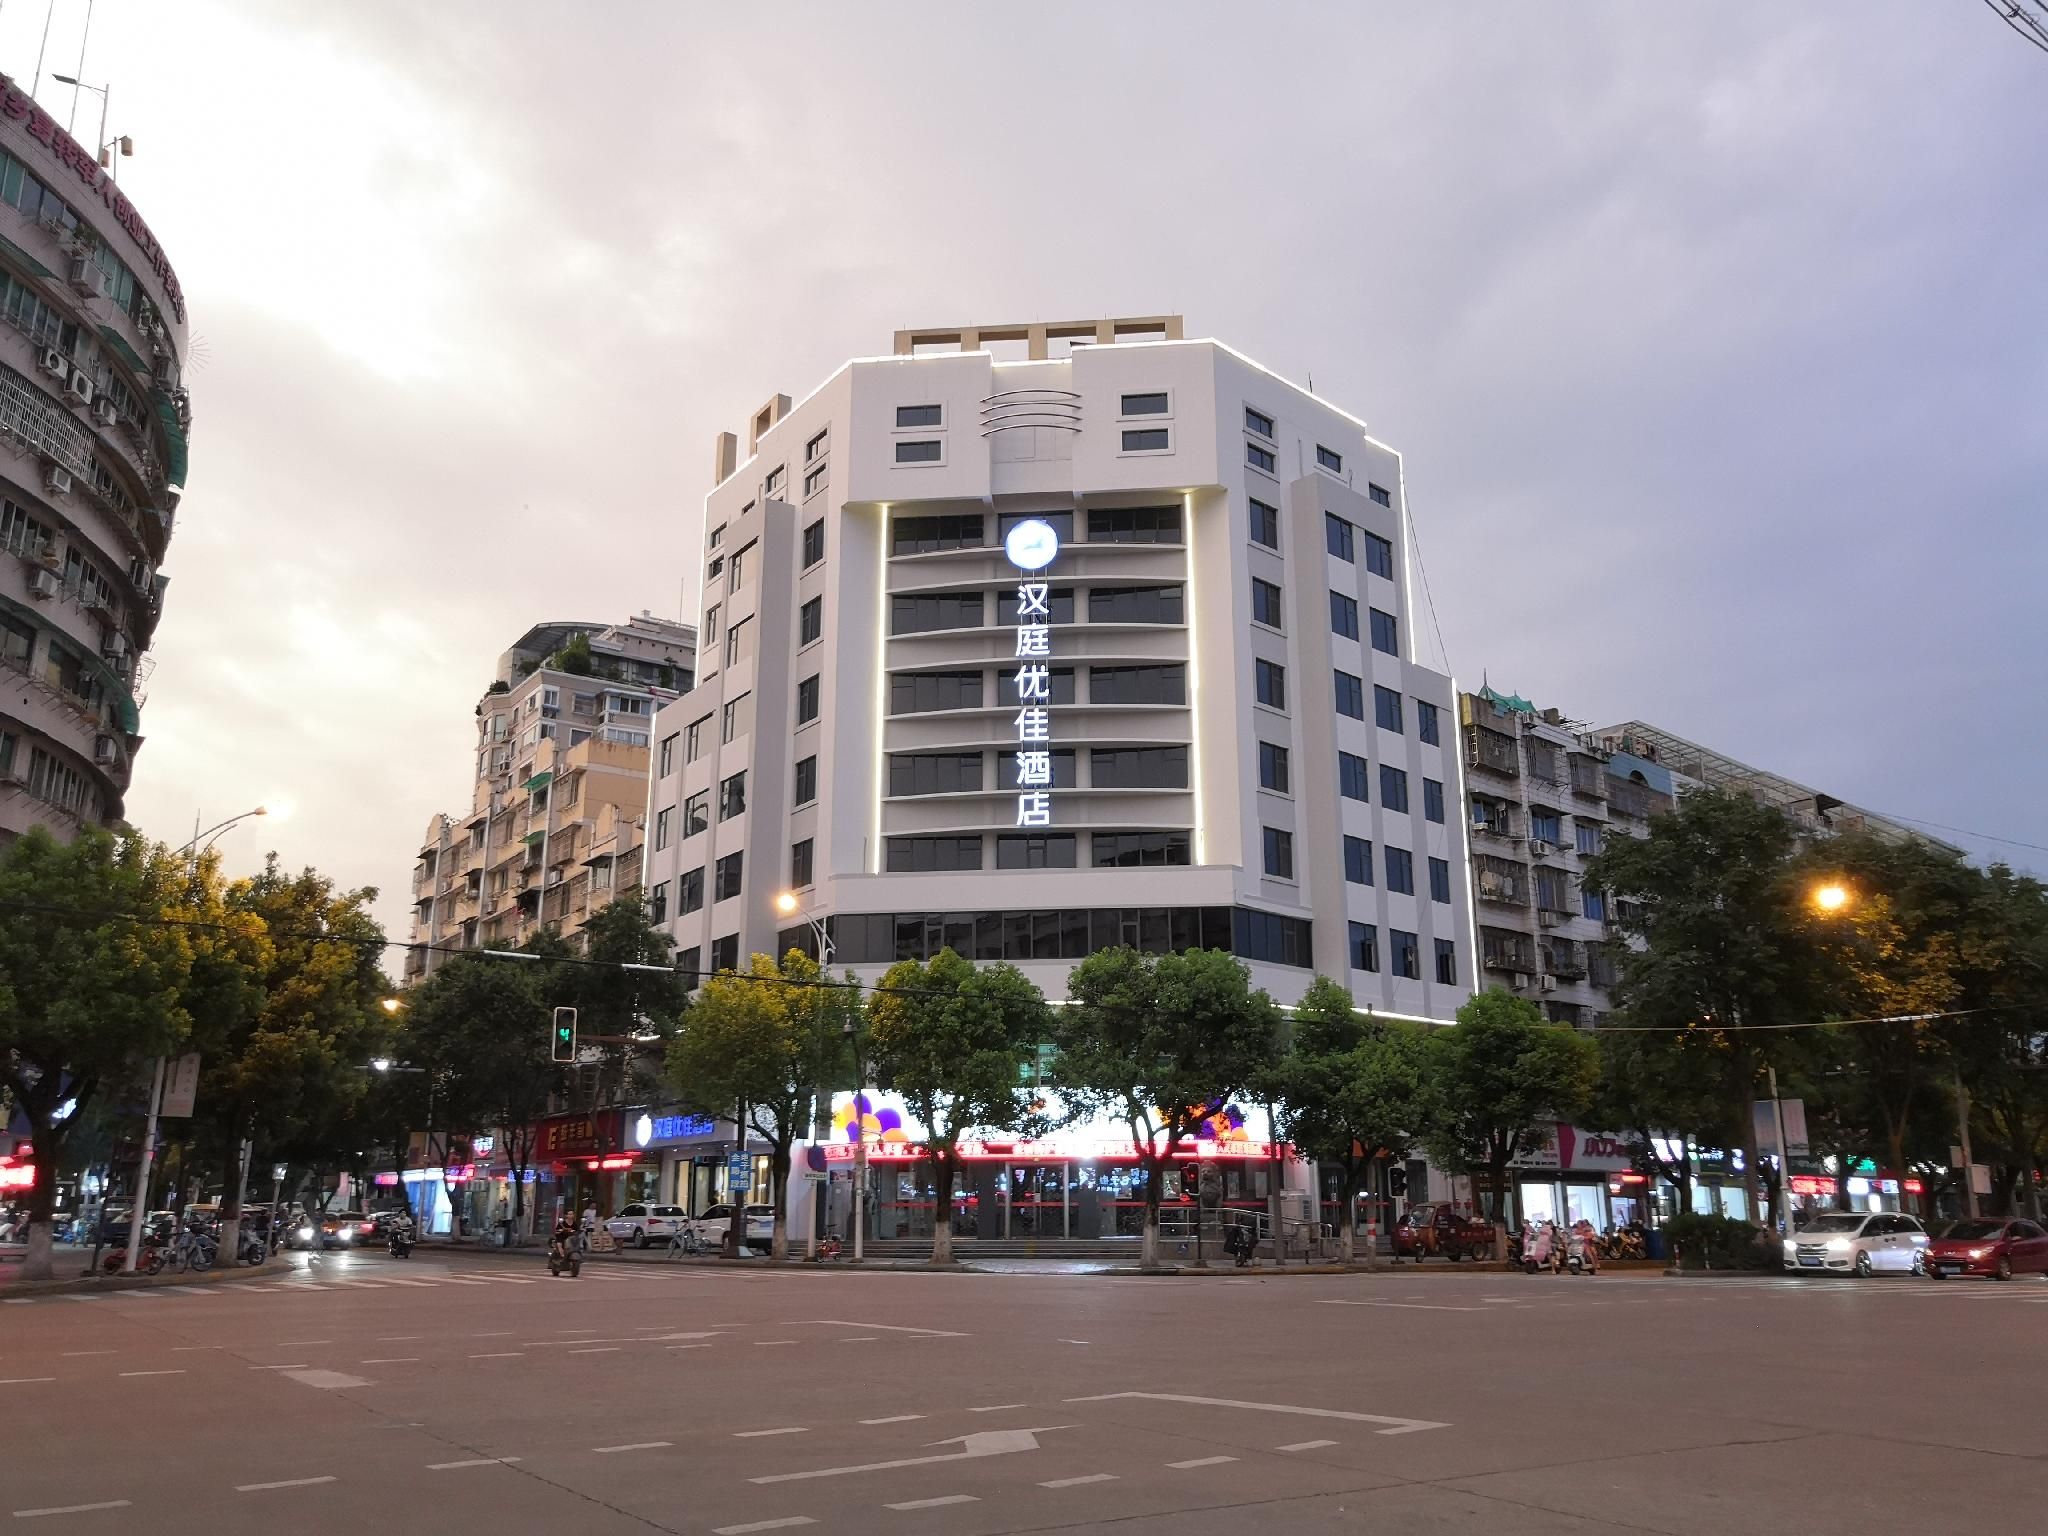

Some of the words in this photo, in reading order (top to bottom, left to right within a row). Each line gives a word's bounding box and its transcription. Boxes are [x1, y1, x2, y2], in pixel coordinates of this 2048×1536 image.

[1014, 583, 1050, 826] 汉庭优佳酒店
